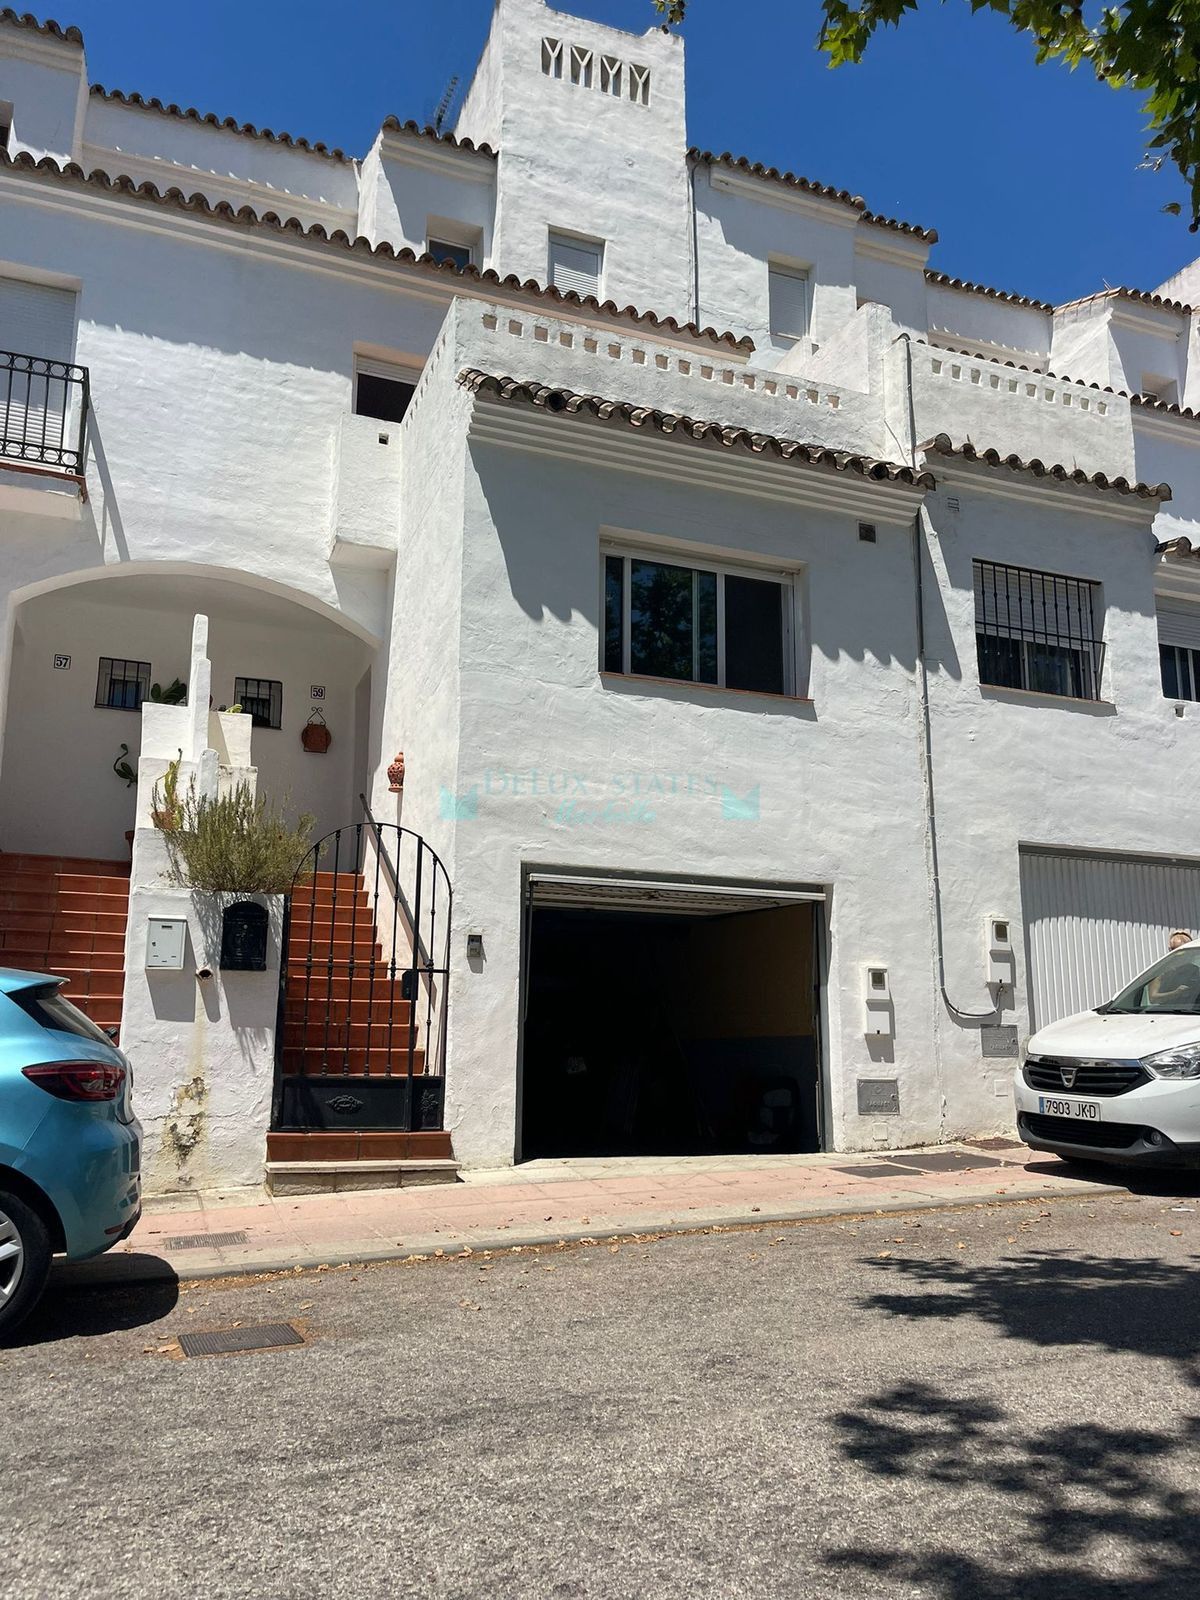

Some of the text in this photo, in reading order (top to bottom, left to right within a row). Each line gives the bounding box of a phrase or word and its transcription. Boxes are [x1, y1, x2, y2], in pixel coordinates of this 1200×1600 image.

[56, 656, 69, 668] 57
[312, 687, 323, 698] 59
[1046, 1100, 1097, 1119] 7903 JKD
